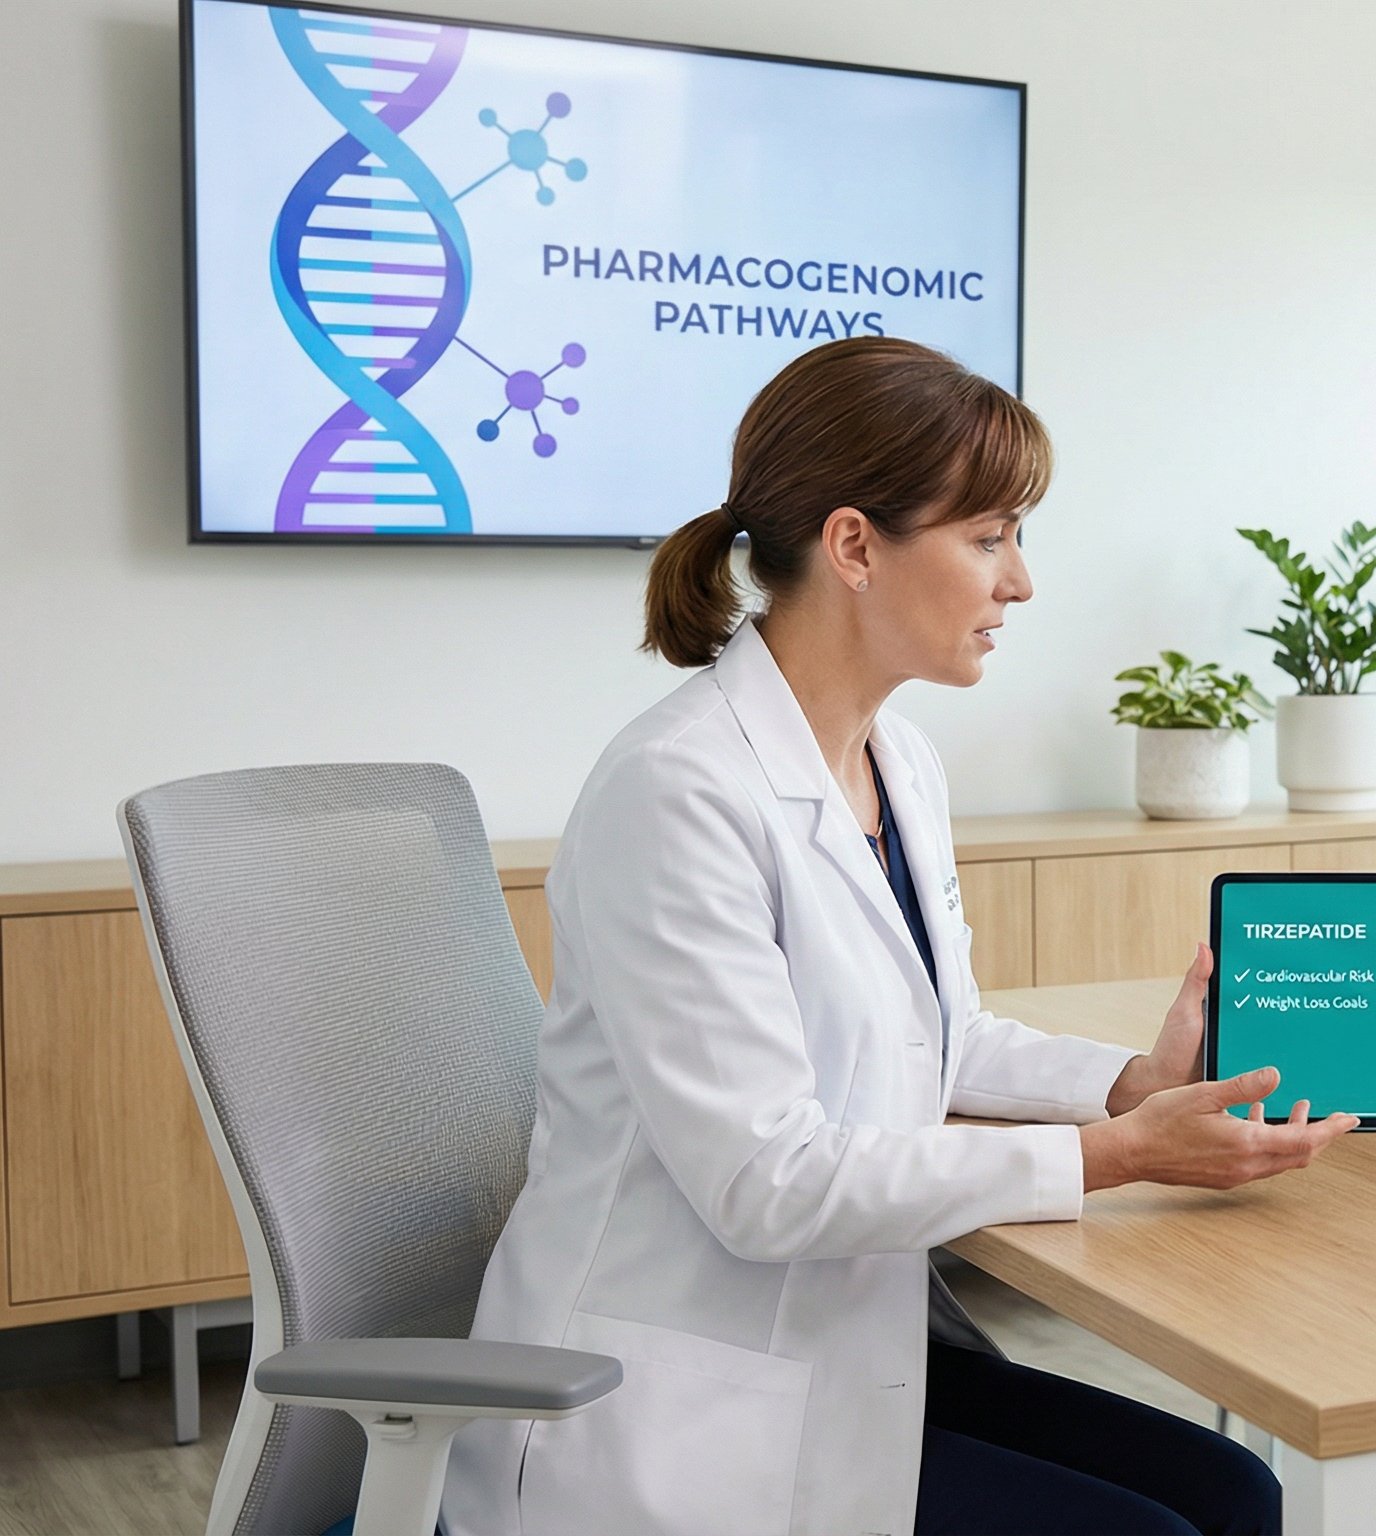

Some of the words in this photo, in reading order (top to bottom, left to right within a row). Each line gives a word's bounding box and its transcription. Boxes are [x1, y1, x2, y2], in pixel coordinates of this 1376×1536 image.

[542, 244, 984, 301] PHARMACOGENOMIC
[654, 300, 885, 339] PATHWAYS
[1243, 924, 1366, 939] TIRZEPATIDE
[1256, 969, 1346, 982] Cardiovascular
[1349, 969, 1375, 982] Risk
[1255, 996, 1300, 1011] Weight
[1333, 995, 1368, 1008] Goals
